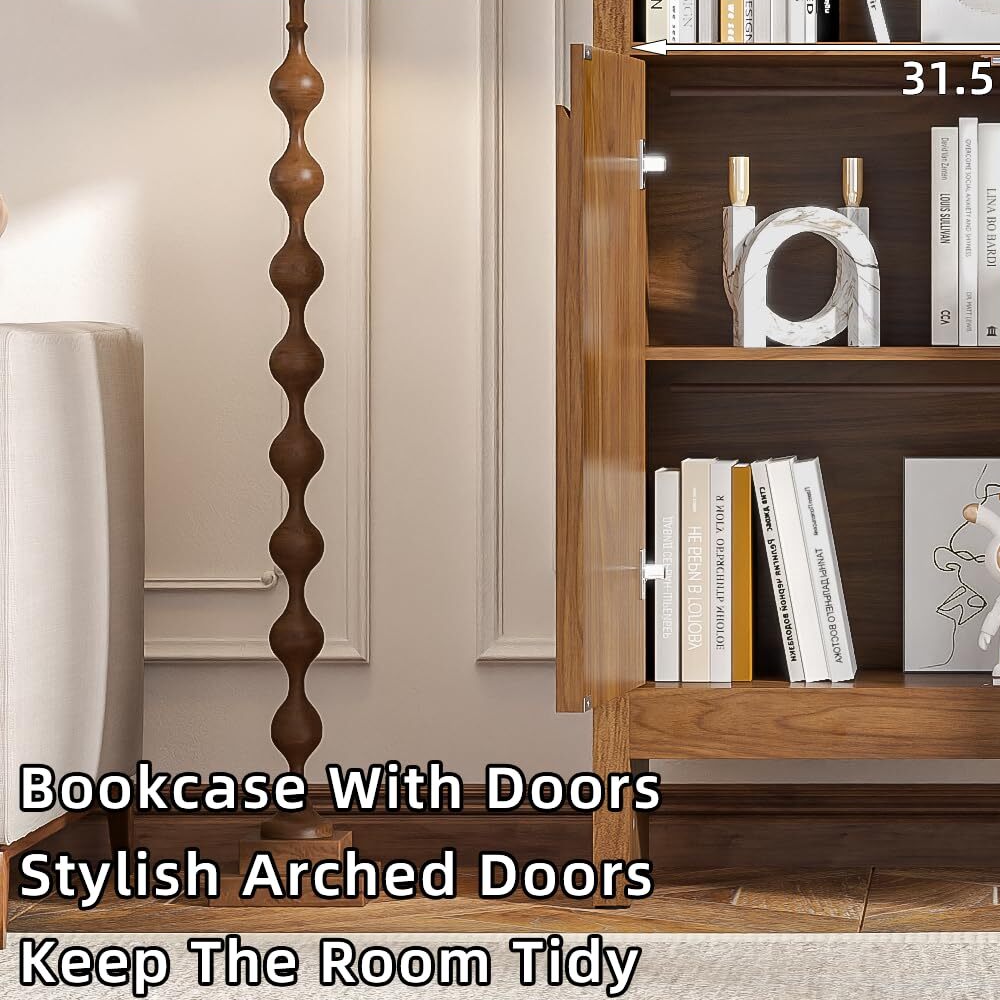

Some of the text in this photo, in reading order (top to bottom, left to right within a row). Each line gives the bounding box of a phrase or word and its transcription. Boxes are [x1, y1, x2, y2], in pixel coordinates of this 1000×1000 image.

[728, 4, 736, 19] we
[940, 193, 950, 244] LOUIS SULLIVAN
[986, 188, 997, 267] LINA BO BARDI
[940, 309, 950, 325] CCA
